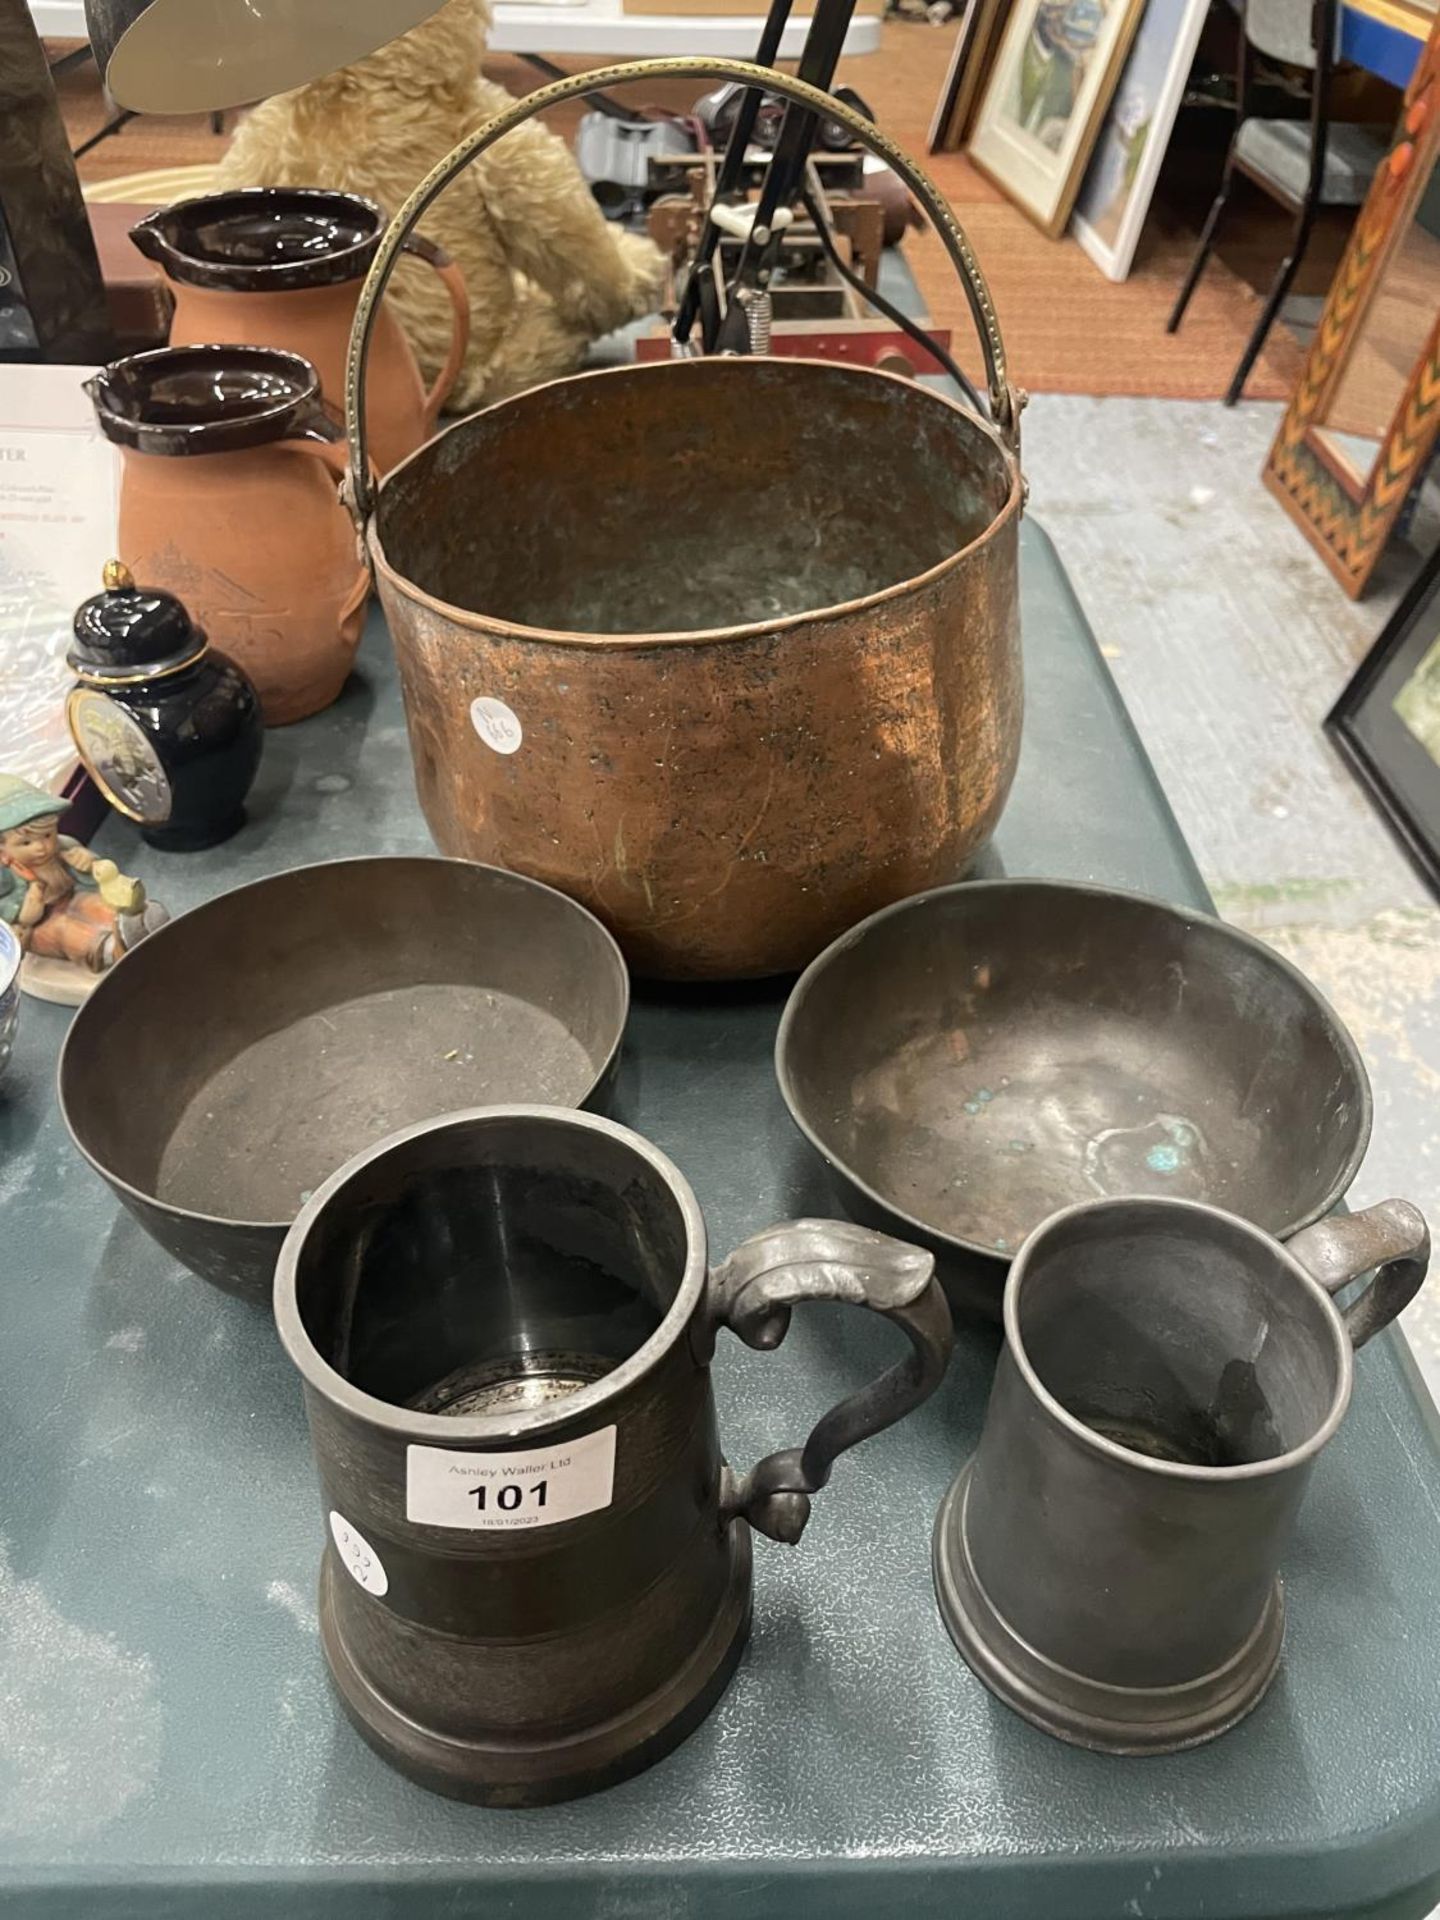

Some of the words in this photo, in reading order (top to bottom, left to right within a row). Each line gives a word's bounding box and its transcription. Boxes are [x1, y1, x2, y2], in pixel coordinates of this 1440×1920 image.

[448, 1465, 498, 1477] Ashley
[501, 1463, 546, 1476] Waller
[550, 1457, 571, 1470] Ltd
[468, 1480, 548, 1511] 101
